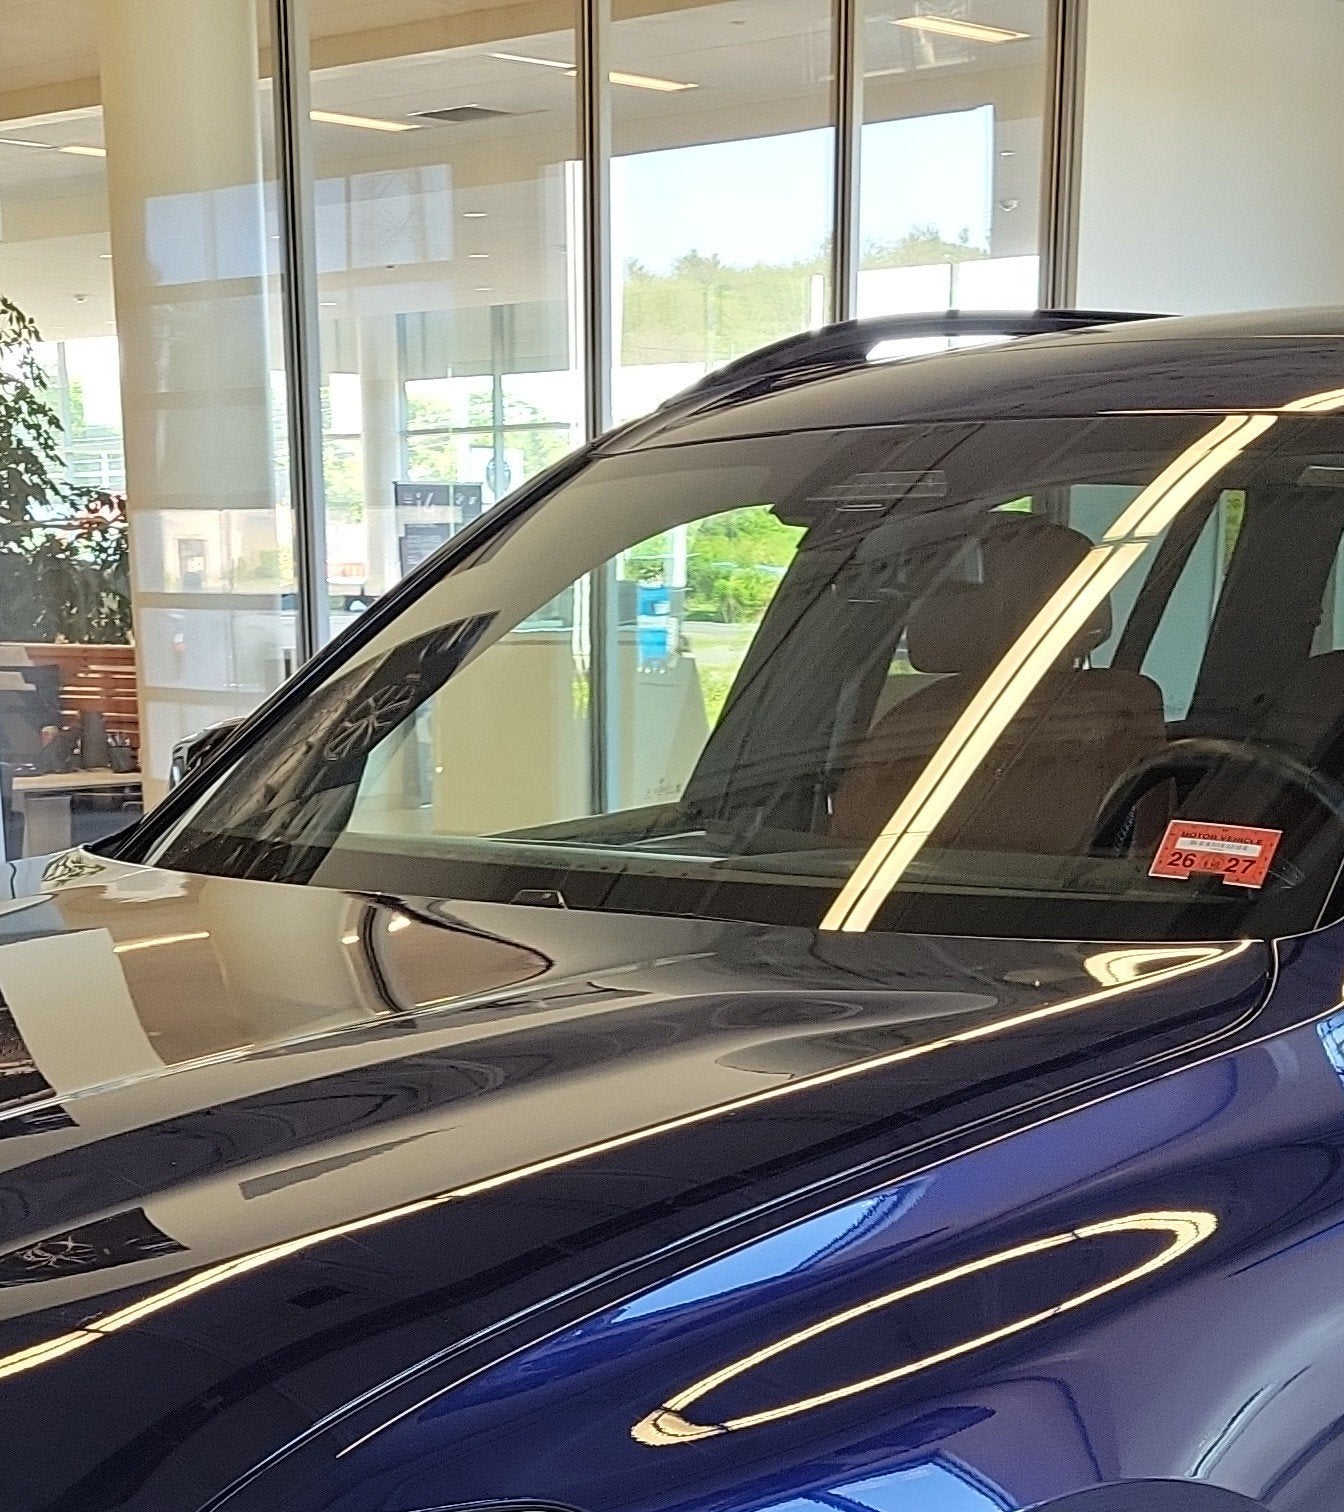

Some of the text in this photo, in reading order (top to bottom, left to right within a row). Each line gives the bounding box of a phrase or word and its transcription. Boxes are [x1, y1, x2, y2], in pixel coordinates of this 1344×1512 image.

[1181, 831, 1264, 845] MOTOR VEHICLE
[1167, 852, 1196, 868] 26
[1224, 858, 1257, 874] 27
